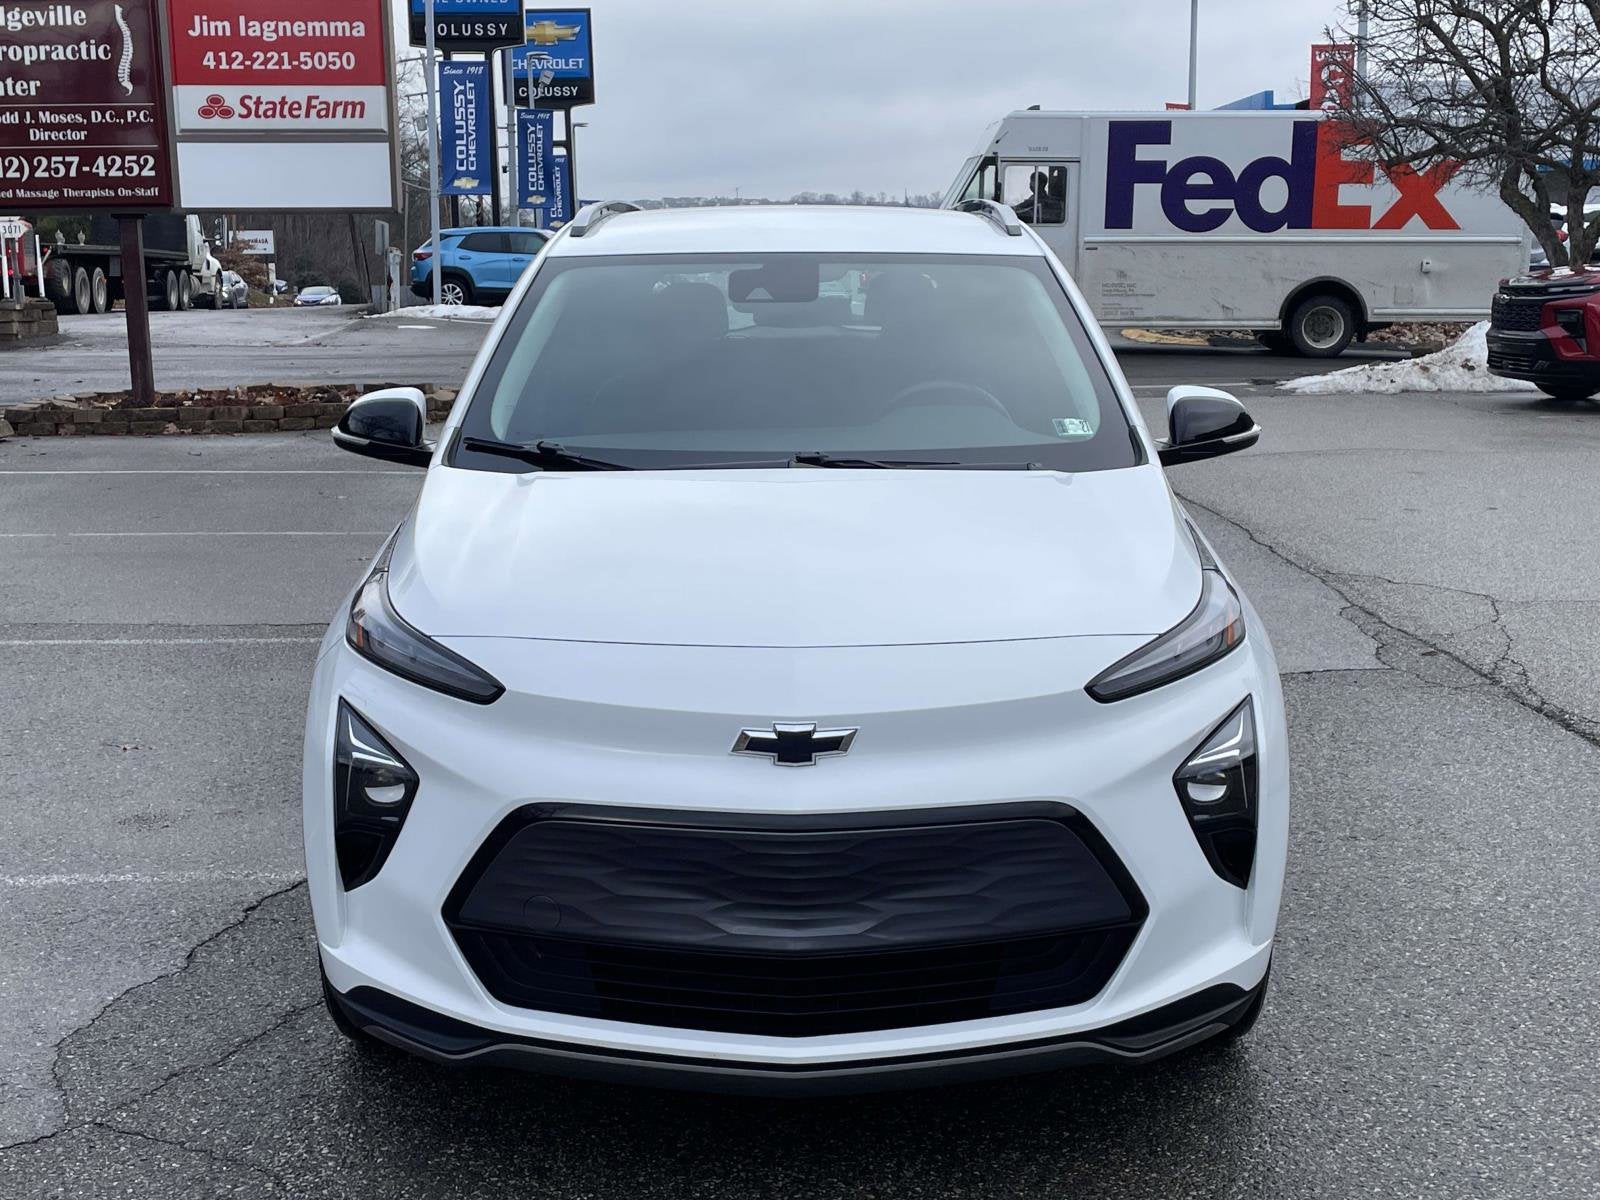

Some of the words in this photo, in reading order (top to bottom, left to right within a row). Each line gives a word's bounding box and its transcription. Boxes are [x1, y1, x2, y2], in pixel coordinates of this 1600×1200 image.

[188, 15, 231, 37] Jim
[239, 15, 366, 42] Iagnemma
[425, 23, 508, 36] OLUSSY
[202, 51, 356, 70] 412-221-5050
[443, 66, 463, 75] Since
[466, 66, 484, 75] 1918
[0, 111, 19, 124] dd
[23, 111, 35, 124] J.
[38, 110, 87, 125] Moses,
[91, 110, 124, 125] D.C.,
[127, 110, 154, 123] P.C.
[453, 79, 467, 171] COLUSSY
[466, 79, 477, 171] CHEVROLET
[29, 128, 87, 141] Director
[527, 123, 537, 191] COLUSSY
[536, 123, 545, 191] CHEVROLET
[1104, 120, 1462, 233] FedEx
[0, 189, 13, 198] ed
[16, 188, 59, 199] Massage
[62, 187, 115, 199] Therapists
[117, 187, 159, 197] On-Staff
